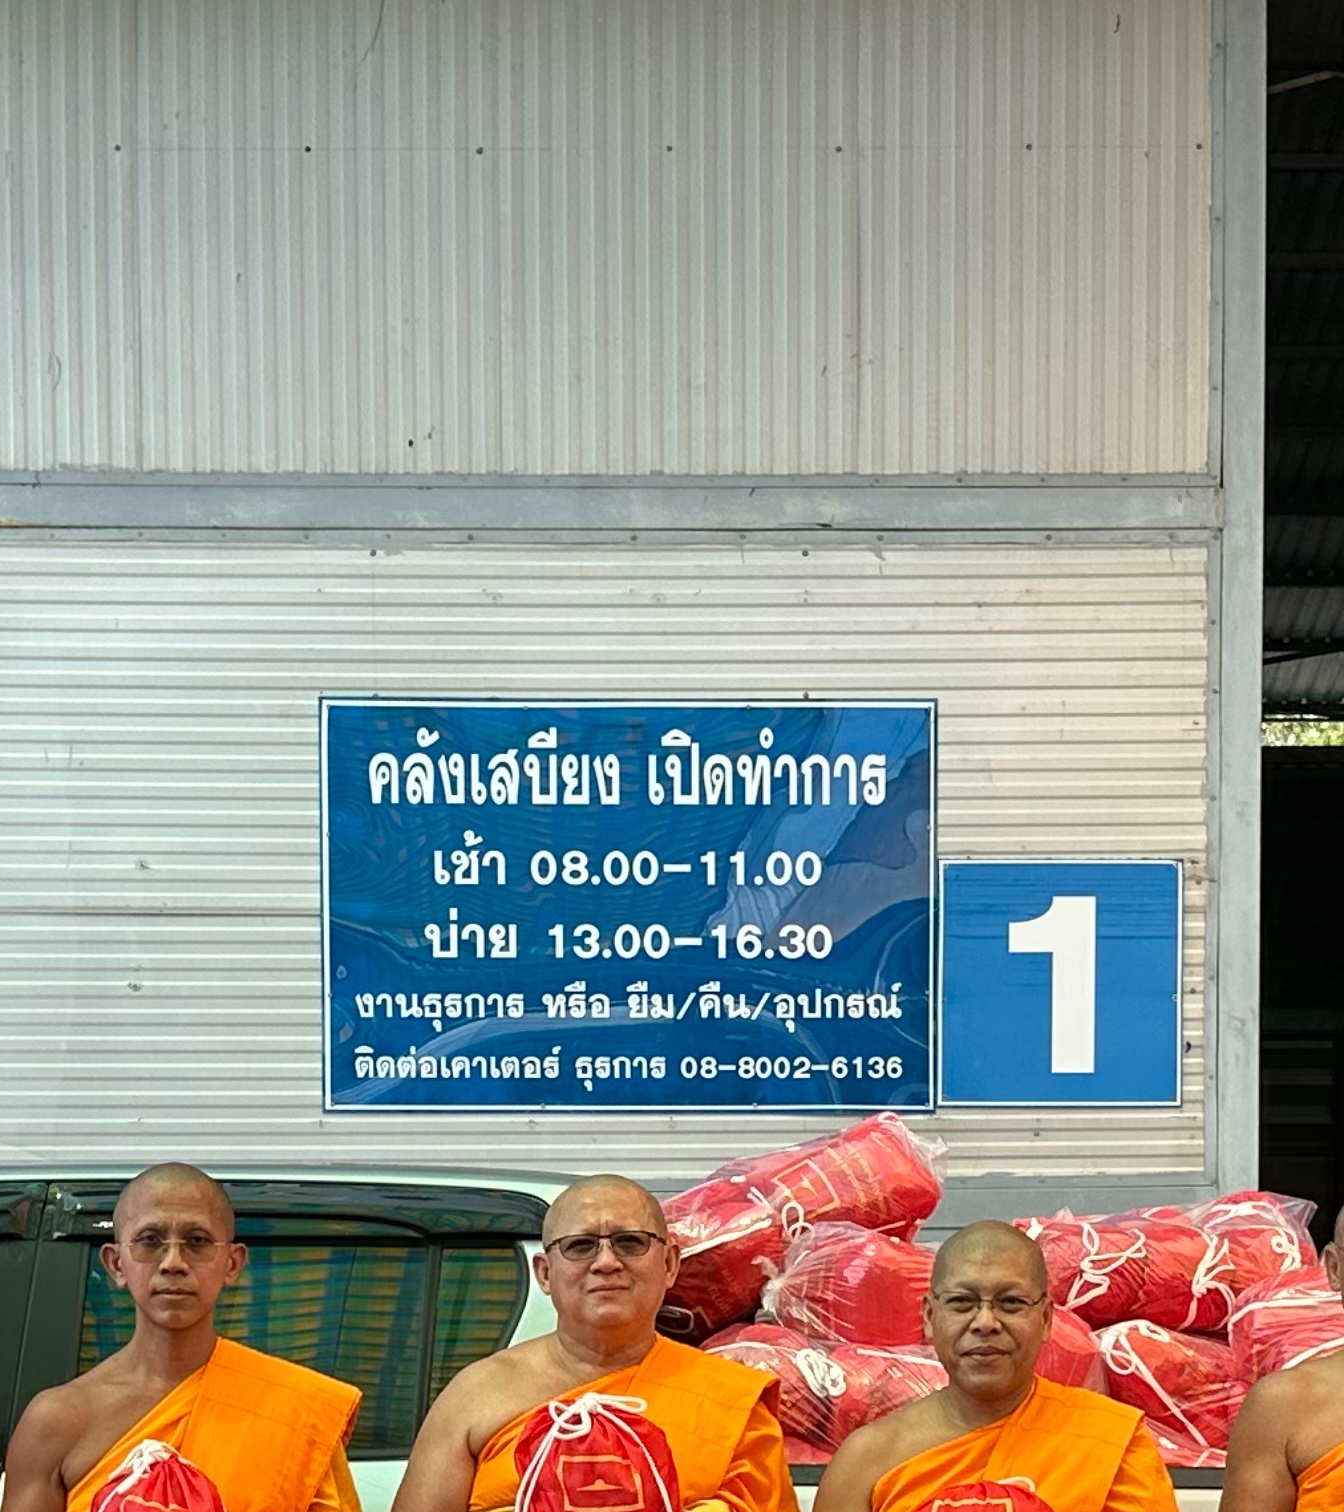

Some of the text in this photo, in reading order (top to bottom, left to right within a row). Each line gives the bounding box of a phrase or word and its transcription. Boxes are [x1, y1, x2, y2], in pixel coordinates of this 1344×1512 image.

[368, 727, 887, 807] คลังเสบียง เปิดทำการ
[434, 829, 823, 886] เช้า 08.00-11.00
[424, 907, 833, 960] บ่าย 13.00-16.30
[355, 980, 903, 1033] งานธุรการ หรือ ยืม/คืน/อุปกรณ์
[1008, 895, 1097, 1074] 1
[354, 1045, 903, 1091] ติดต่อเคาเตอร์ ธุรการ 08-8002-6136
